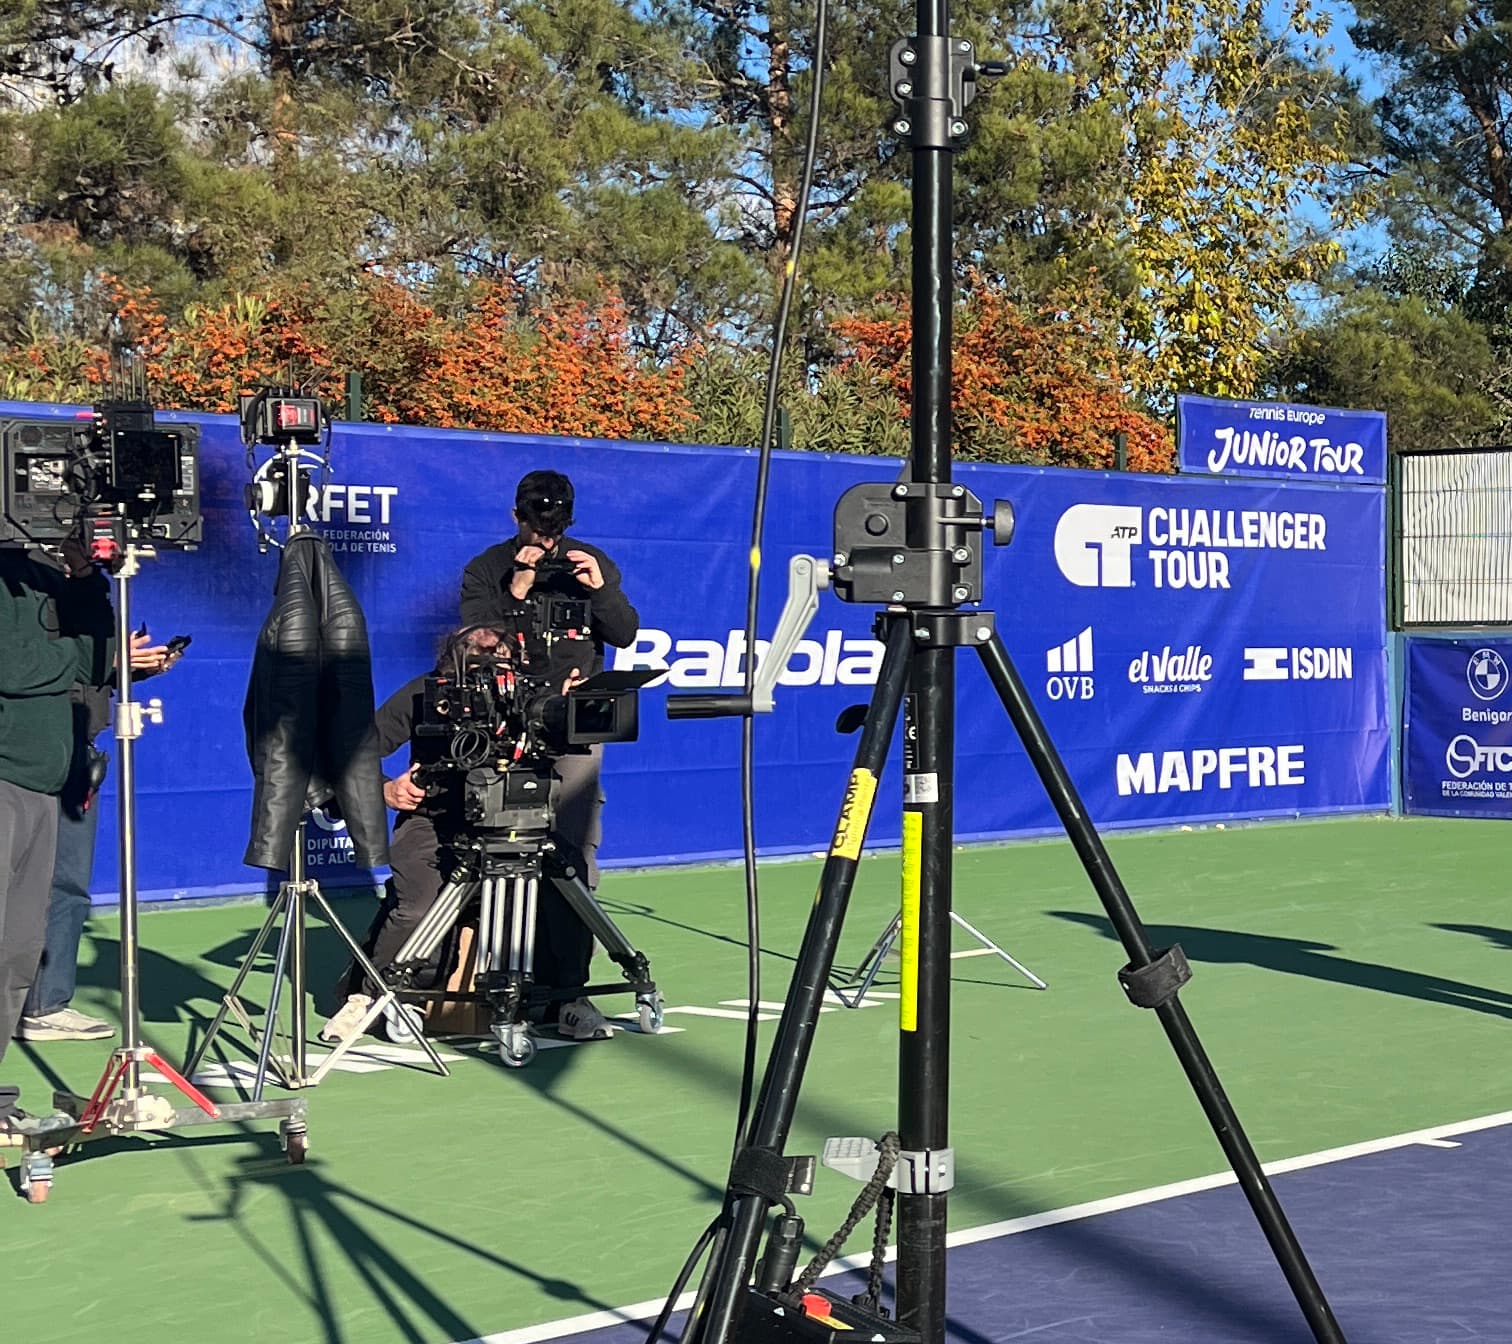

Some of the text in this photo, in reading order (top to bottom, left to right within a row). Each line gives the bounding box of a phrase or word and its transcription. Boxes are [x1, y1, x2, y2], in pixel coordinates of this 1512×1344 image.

[323, 529, 390, 541] FEDERACIÓN
[1111, 526, 1138, 539] ATP
[1149, 507, 1326, 550] CHALLENGER
[350, 542, 364, 553] DE
[366, 542, 397, 553] TENIS
[1149, 550, 1231, 589] TOUR
[612, 629, 886, 688] Babola
[1128, 646, 1212, 682] el Valle
[1292, 647, 1352, 679] ISDIN
[1046, 676, 1094, 700] OVB
[1462, 707, 1512, 725] Benigar
[1116, 745, 1305, 796] MAPFRE
[1442, 780, 1493, 791] FEDERACIÓN
[307, 836, 354, 850] DIPUTA
[307, 851, 356, 866] DE ALIC
